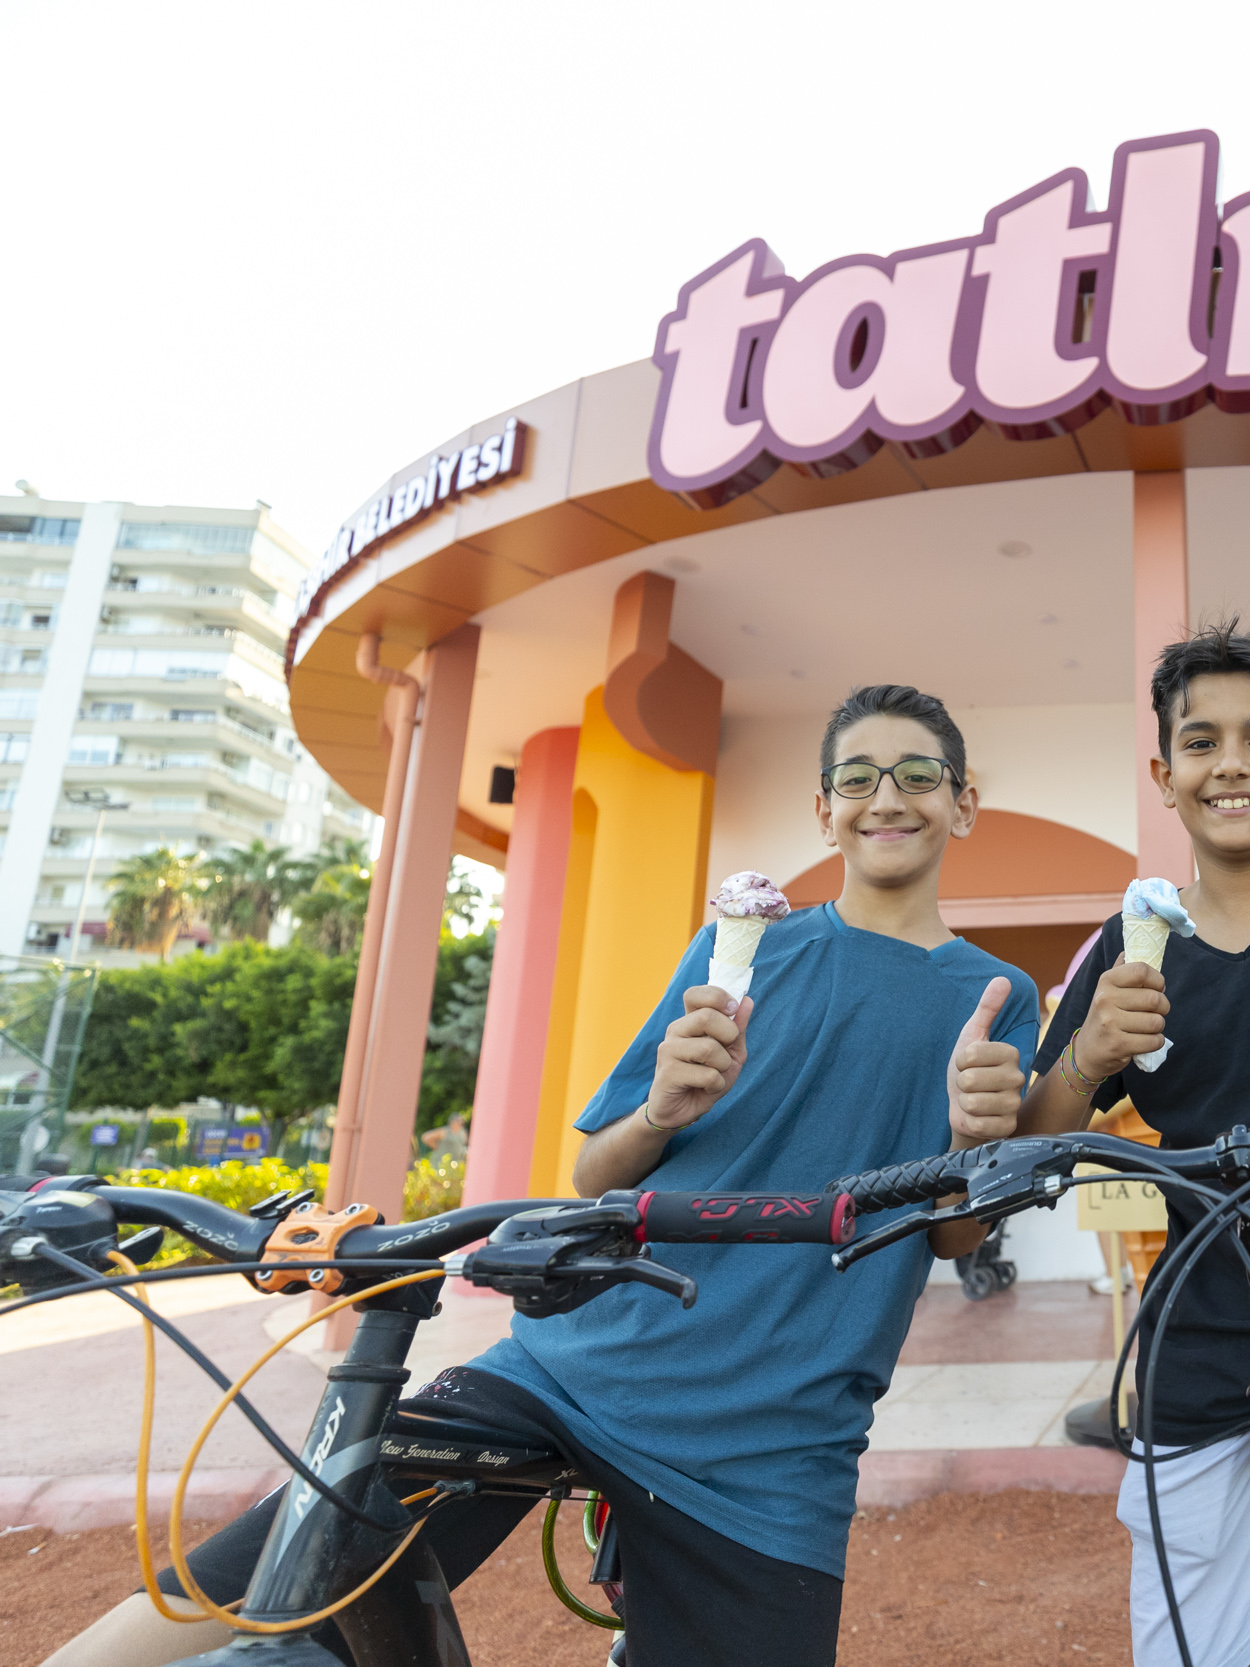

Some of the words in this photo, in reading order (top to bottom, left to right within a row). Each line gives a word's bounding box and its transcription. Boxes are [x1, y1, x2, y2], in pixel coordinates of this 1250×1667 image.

[350, 416, 518, 557] BELEDİYESİ
[1101, 1181, 1131, 1200] LA
[380, 1439, 403, 1456] New
[402, 1443, 462, 1461] Generation
[477, 1450, 510, 1467] Design
